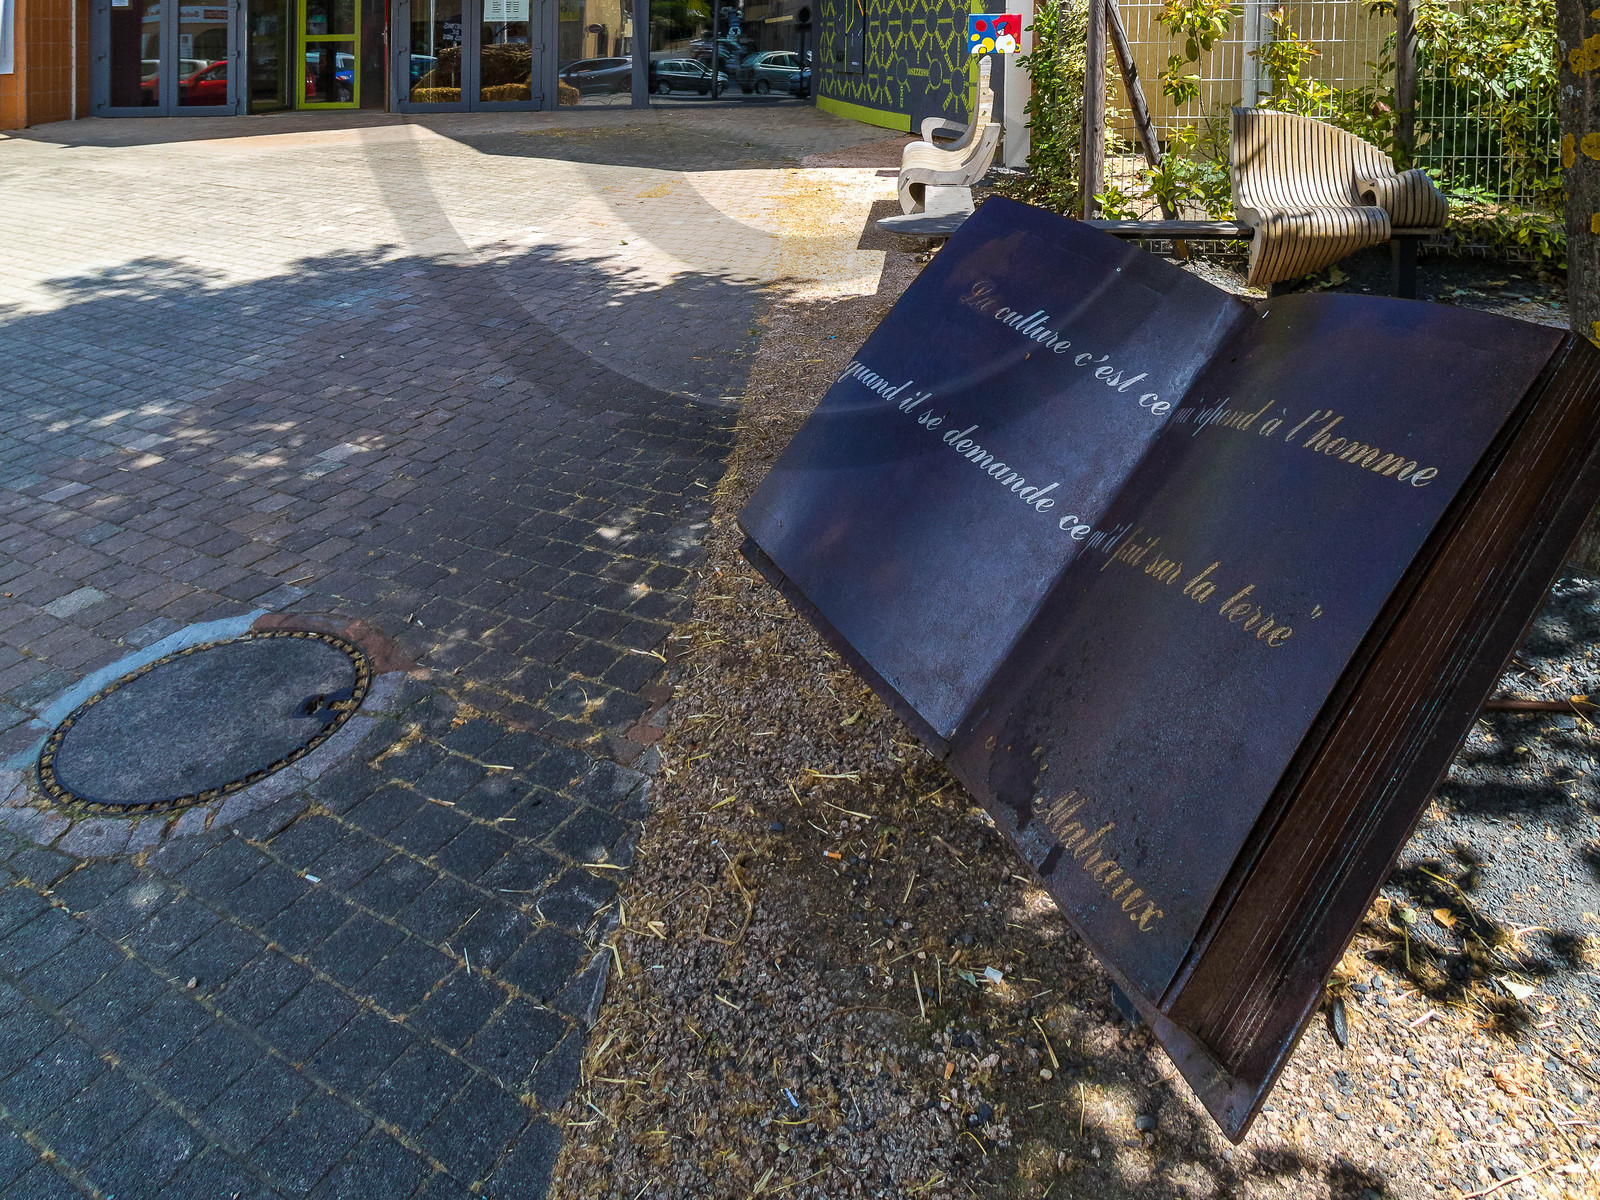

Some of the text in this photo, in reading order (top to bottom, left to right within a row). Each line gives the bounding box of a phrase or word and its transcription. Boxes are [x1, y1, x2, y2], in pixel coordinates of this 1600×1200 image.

[837, 360, 914, 400] quand
[994, 307, 1071, 353] culture
[1074, 352, 1148, 393] c'est
[1138, 393, 1171, 416] ce
[1191, 397, 1275, 437] répond
[1259, 408, 1287, 437] à
[1285, 409, 1439, 487] l'homme
[898, 391, 933, 413] il
[917, 408, 942, 430] se
[942, 424, 1060, 512] demande
[1058, 515, 1091, 540] ce
[1077, 523, 1134, 560] qu'il
[1100, 526, 1160, 571] fait
[1145, 553, 1183, 585] sur
[1183, 561, 1221, 603] la
[1031, 790, 1164, 932] Malraux
